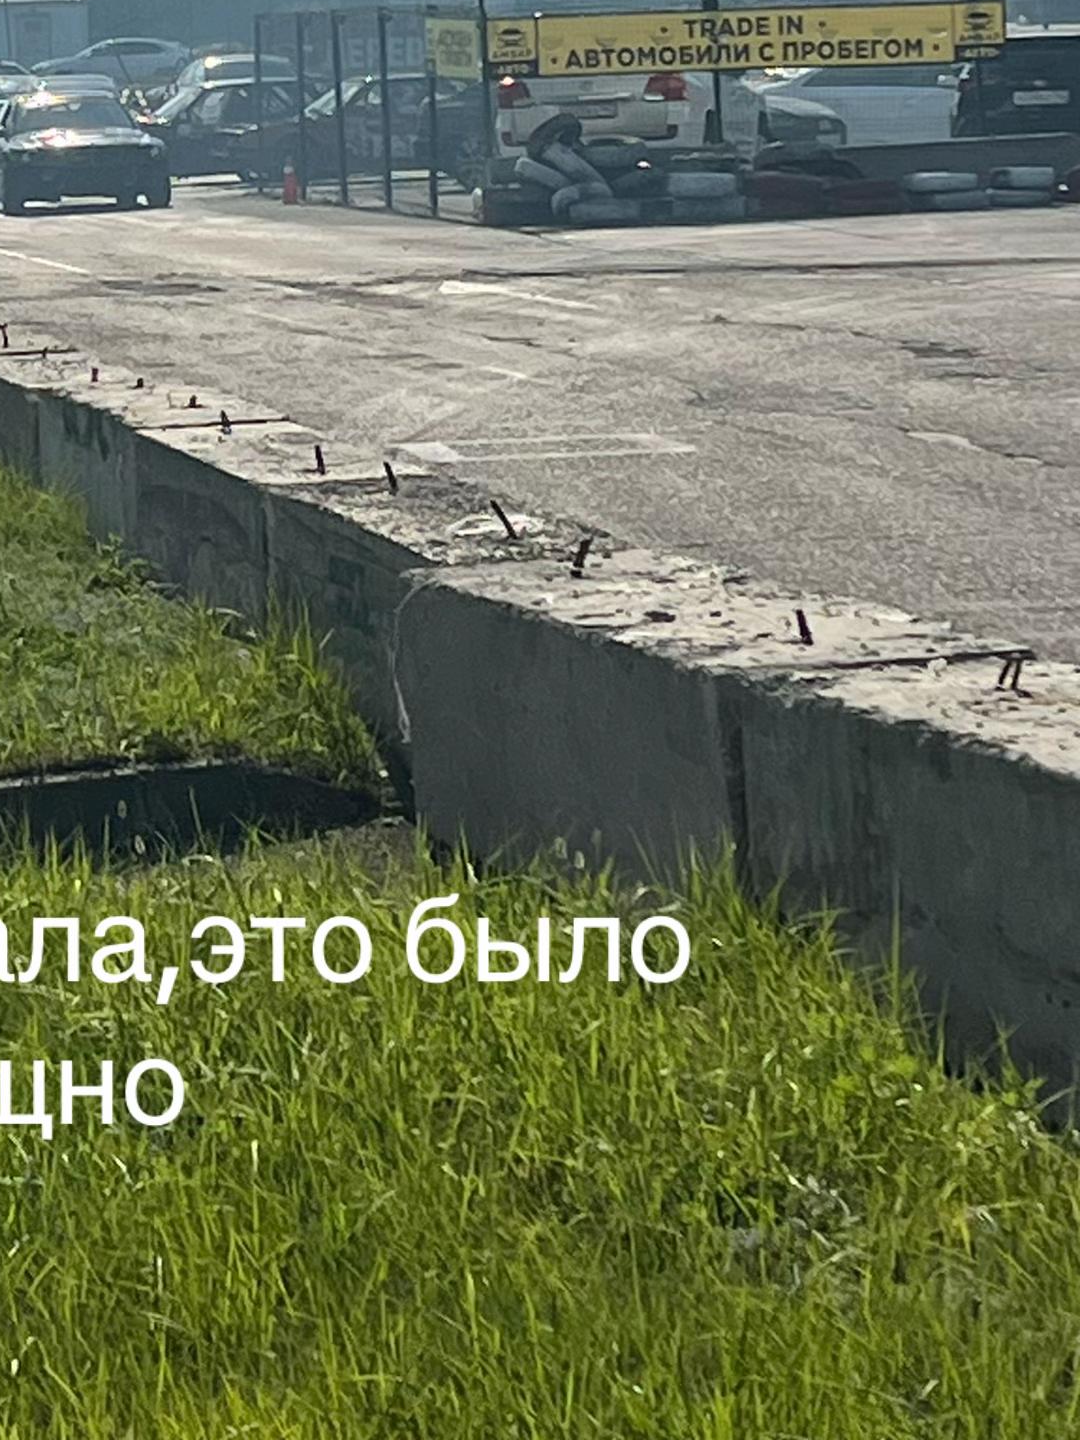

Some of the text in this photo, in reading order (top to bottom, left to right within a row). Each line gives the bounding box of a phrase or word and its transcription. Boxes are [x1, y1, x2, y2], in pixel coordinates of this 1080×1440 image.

[683, 15, 803, 40] TRADE IN
[565, 38, 924, 69] АВТОМОБИЛИ С ПРОБЕГОМ
